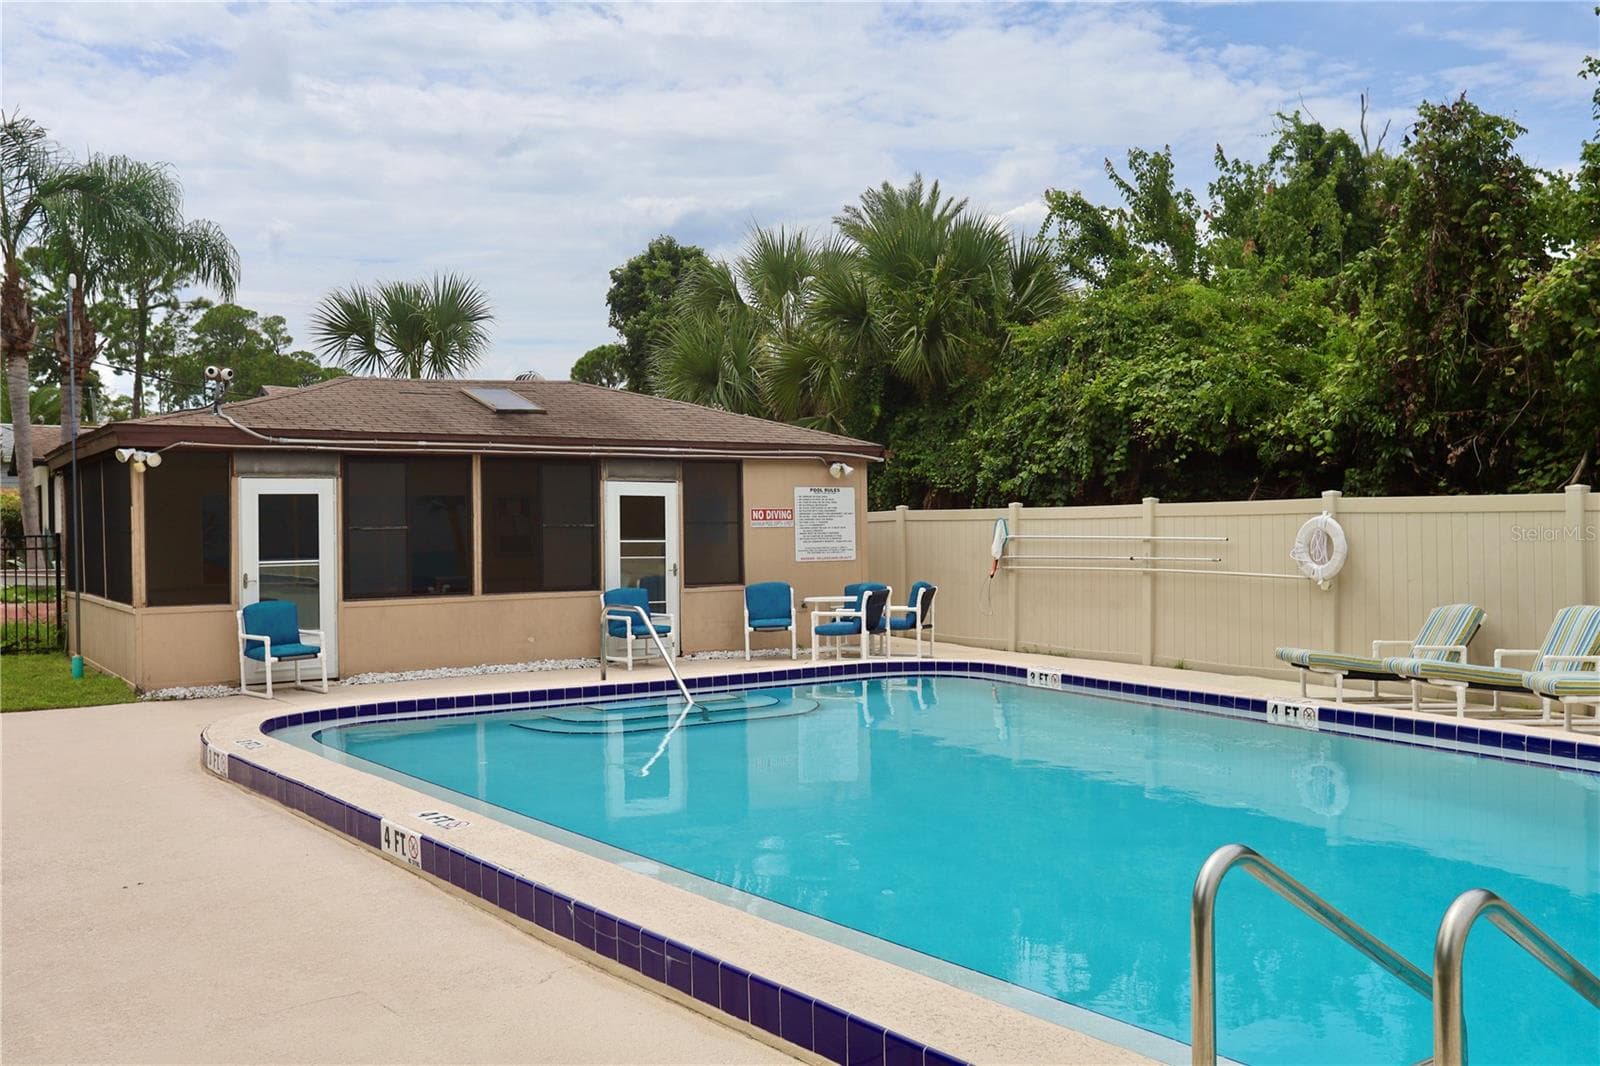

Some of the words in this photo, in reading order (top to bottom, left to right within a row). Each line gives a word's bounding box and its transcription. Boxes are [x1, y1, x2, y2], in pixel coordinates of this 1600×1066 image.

[752, 510, 764, 519] NO
[766, 510, 792, 519] DIVING
[384, 826, 391, 849] 4
